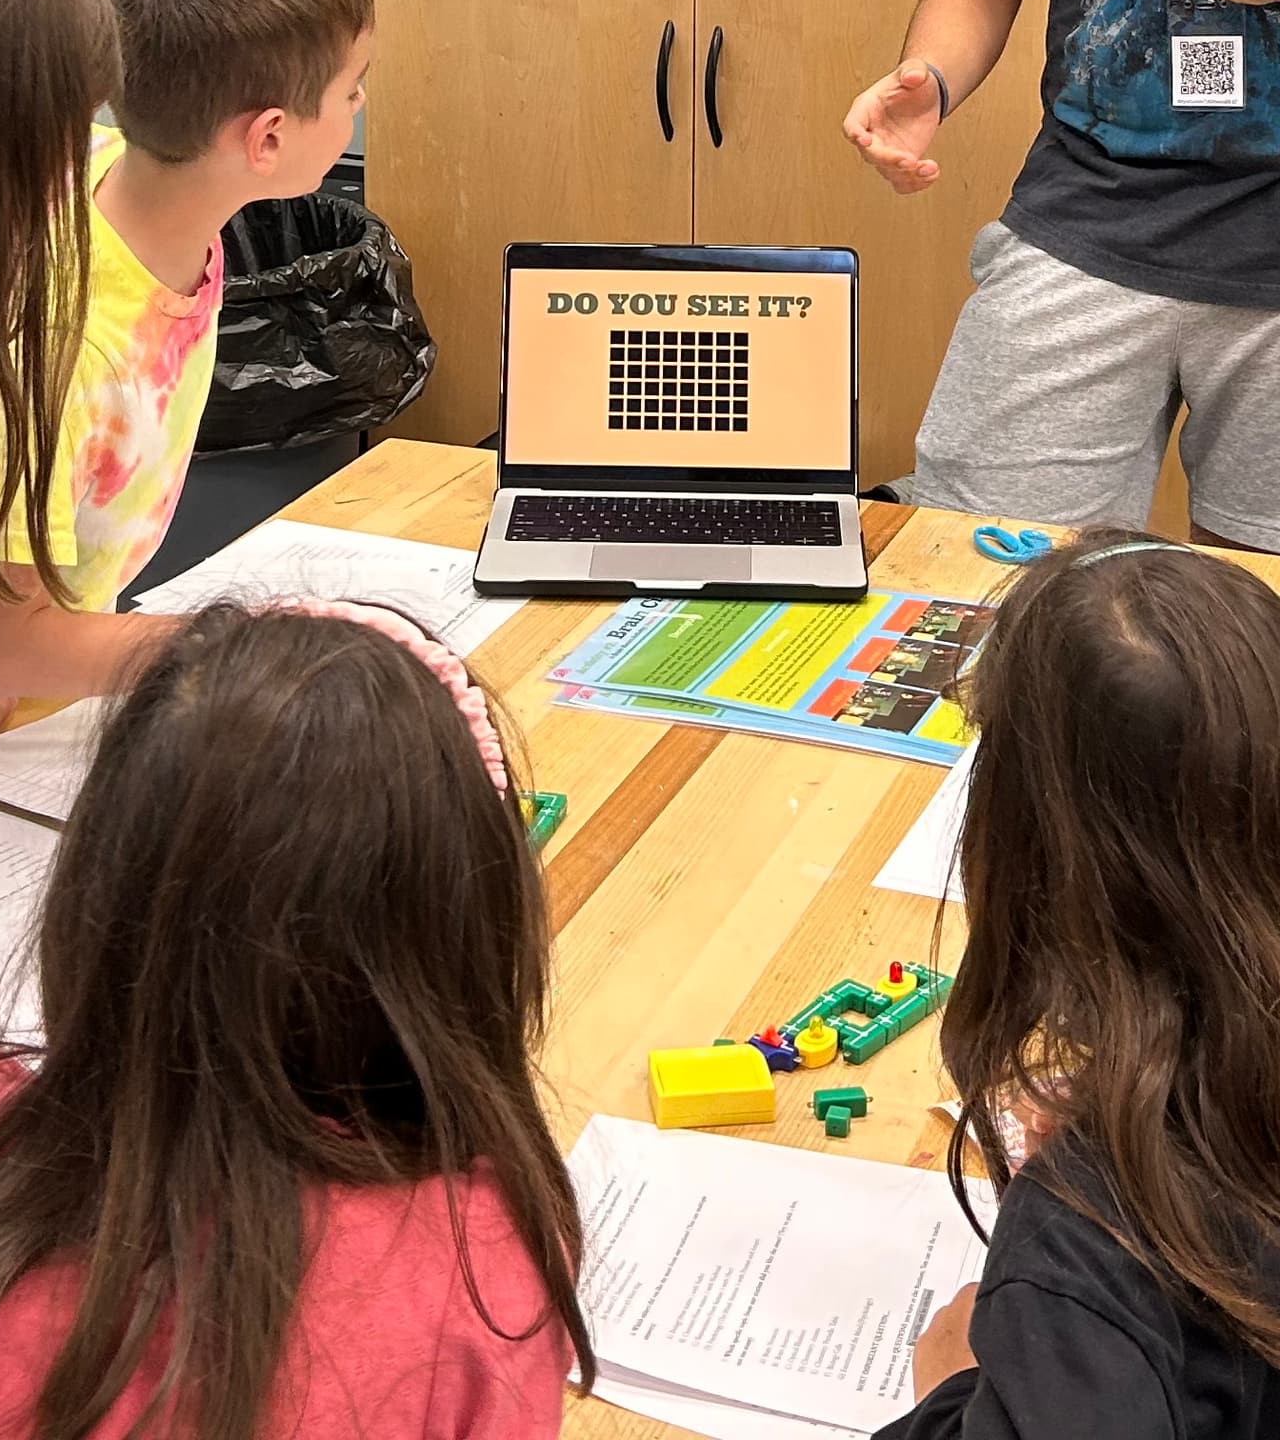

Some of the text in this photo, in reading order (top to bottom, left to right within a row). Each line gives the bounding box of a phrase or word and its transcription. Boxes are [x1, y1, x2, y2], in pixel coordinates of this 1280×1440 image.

[547, 292, 812, 318] DO YOU SEE IT?
[606, 609, 643, 640] Brain
